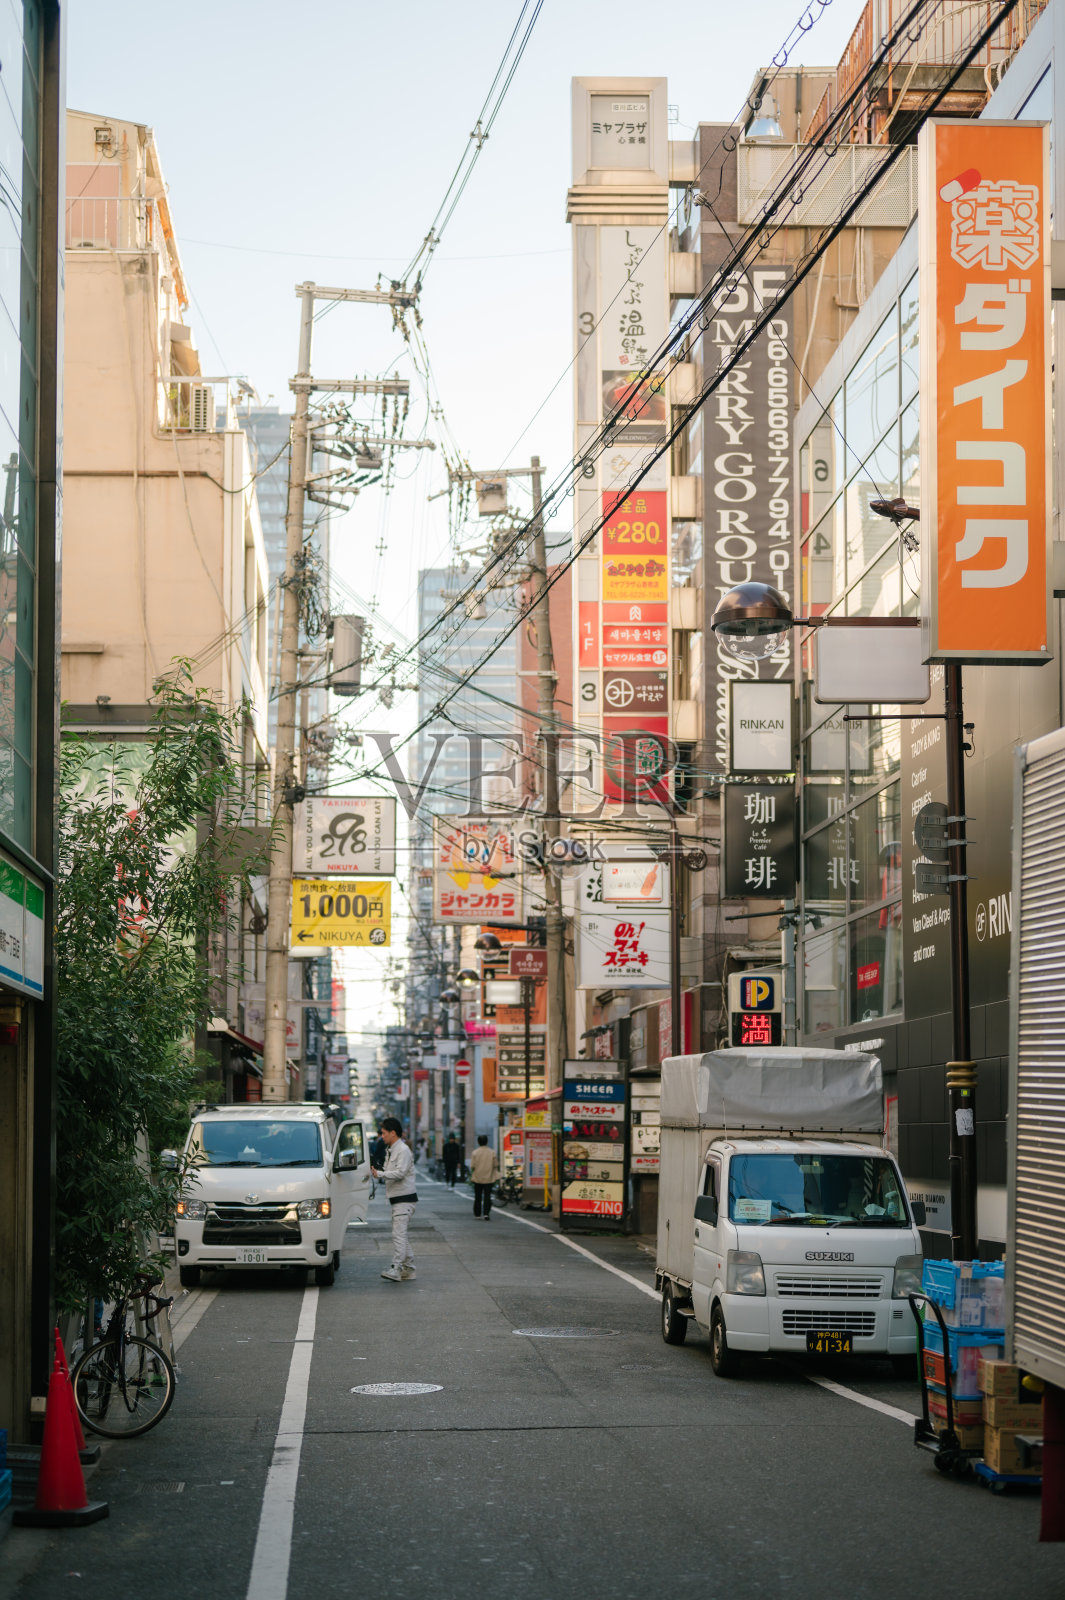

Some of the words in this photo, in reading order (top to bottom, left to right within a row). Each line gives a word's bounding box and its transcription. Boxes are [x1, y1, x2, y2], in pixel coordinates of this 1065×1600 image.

[592, 122, 648, 134] ミヤプラザ
[951, 181, 1040, 270] 薬
[579, 312, 595, 335] 3
[953, 279, 1030, 589] ダイコク
[713, 452, 756, 502] GO
[620, 499, 647, 513] 全品
[610, 629, 662, 641] 새마을식당
[582, 683, 596, 701] 3
[740, 719, 784, 730] RINKAN
[911, 768, 928, 789] Cartier
[441, 891, 515, 908] ジャンカラ
[912, 917, 921, 933] Van
[921, 910, 934, 929] Cleef
[319, 931, 363, 941] NIKUYA
[614, 922, 646, 938] Oh!
[614, 939, 640, 953] マイ
[913, 948, 922, 963] and
[922, 944, 936, 961] more
[602, 951, 649, 967] ステーキ
[751, 980, 769, 1007] P
[741, 1014, 771, 1044] 満
[575, 1084, 614, 1094] SHEER
[593, 1201, 623, 1214] ZINO
[805, 1252, 855, 1262] SUZUKI
[815, 1340, 850, 1352] 41-34
